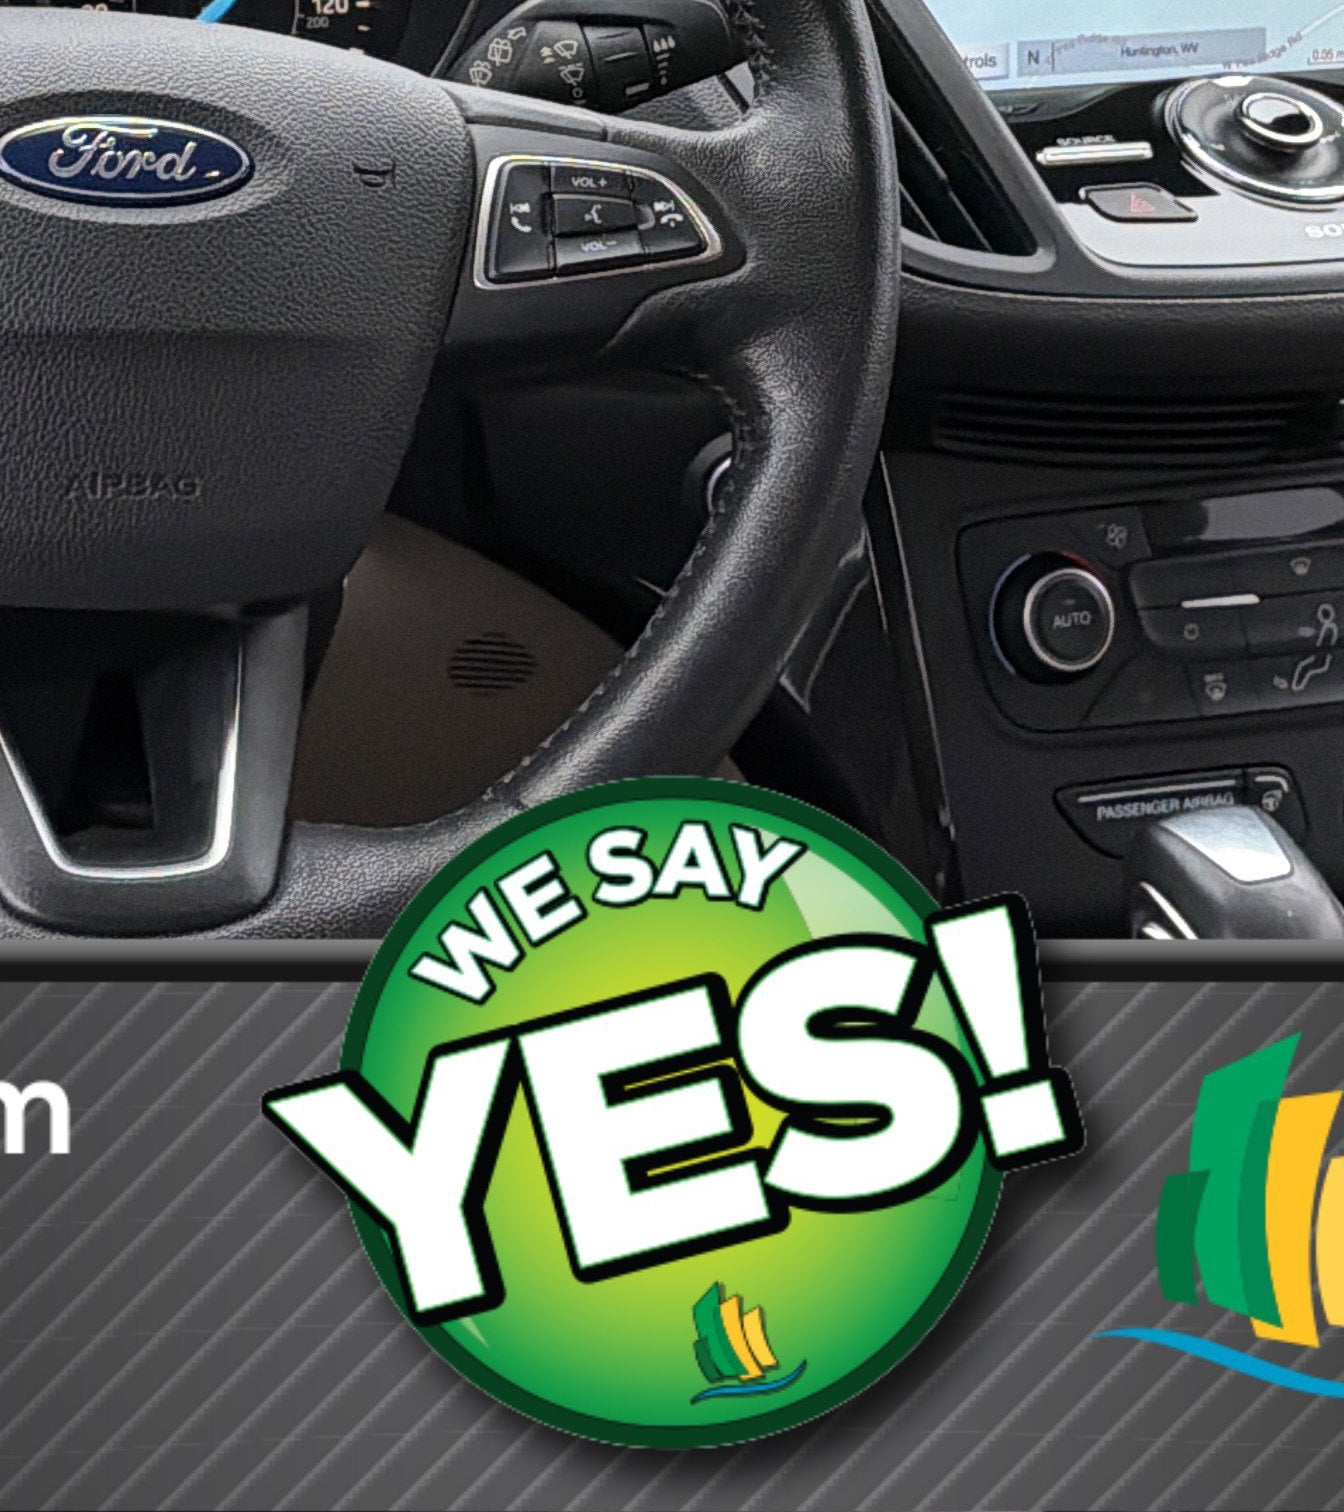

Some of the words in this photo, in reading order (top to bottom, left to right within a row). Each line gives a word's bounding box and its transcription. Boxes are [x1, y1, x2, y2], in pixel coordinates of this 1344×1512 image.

[305, 15, 330, 29] 200
[1180, 42, 1199, 53] WV
[1311, 48, 1335, 61] 0.05
[1027, 49, 1040, 66] N
[47, 123, 198, 181] Ford
[1052, 610, 1092, 630] AUTO
[1097, 797, 1180, 821] PASSENGER
